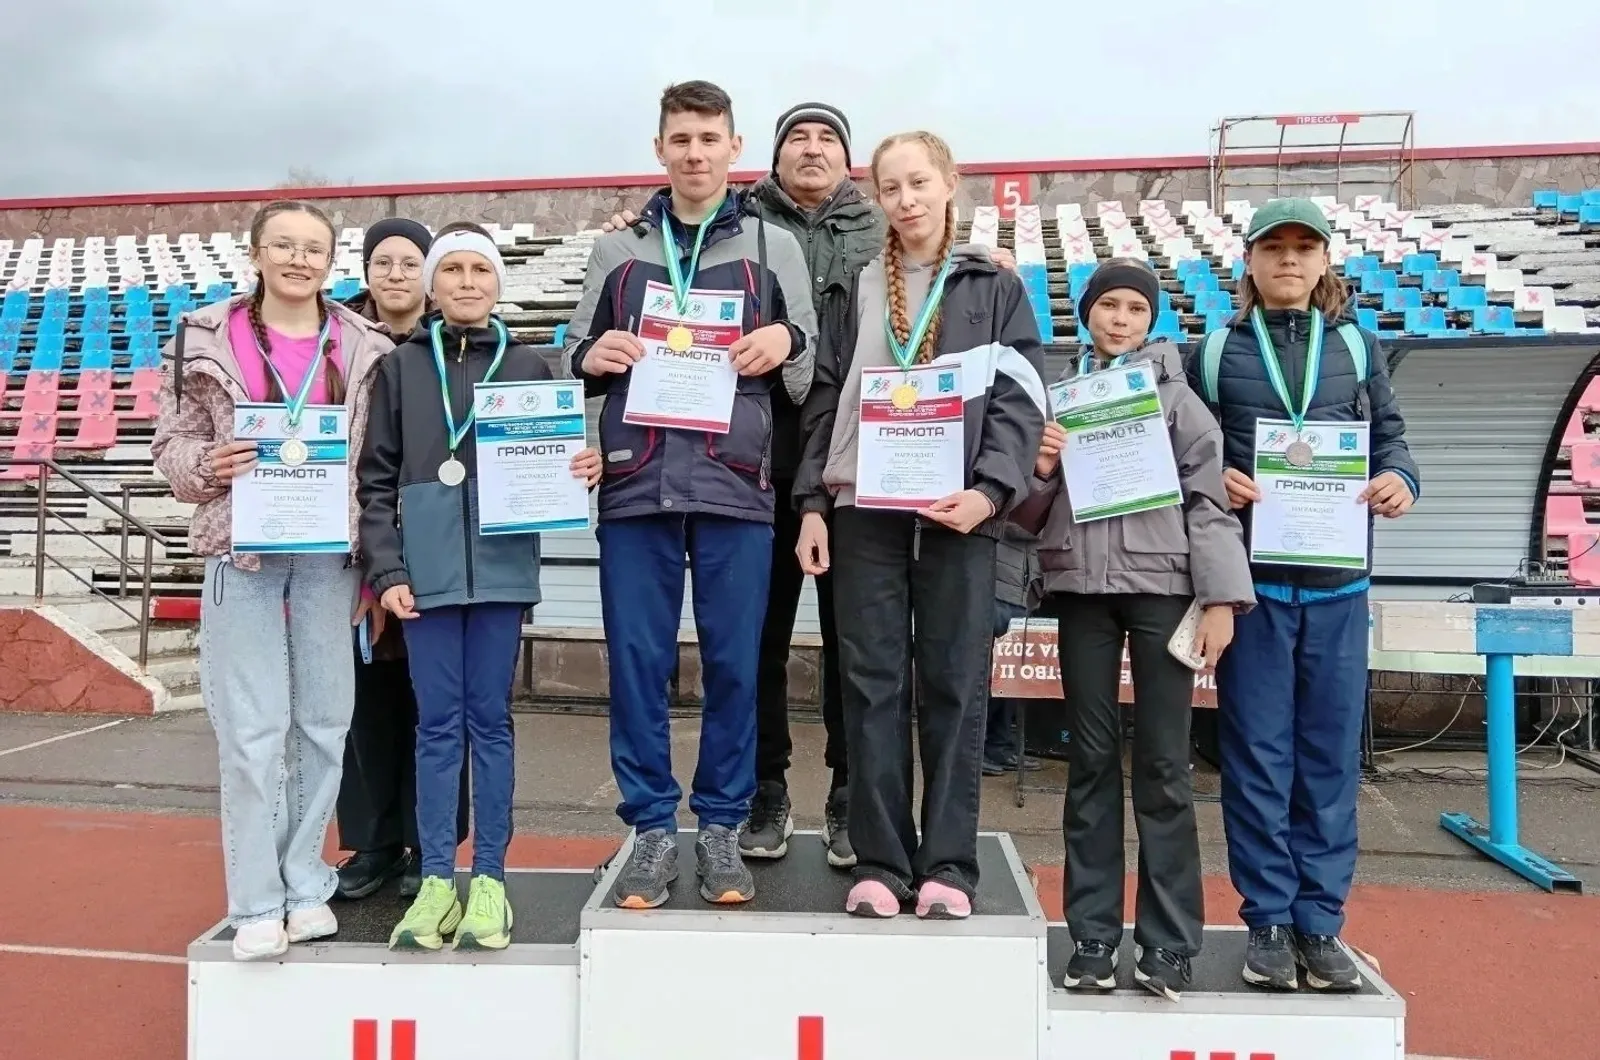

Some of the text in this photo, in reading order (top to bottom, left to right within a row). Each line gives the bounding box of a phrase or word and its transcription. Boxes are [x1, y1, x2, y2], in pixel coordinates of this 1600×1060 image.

[1297, 116, 1339, 124] ПРЕССА
[1003, 181, 1022, 211] 5
[656, 346, 721, 363] ГРАМОТА
[879, 426, 945, 437] ГРАМОТА
[1078, 423, 1145, 444] ГРАМОТА
[497, 444, 566, 457] ГРАМОТА
[254, 468, 327, 478] ГРАМОТА
[1275, 480, 1345, 492] ГРАМОТА
[997, 642, 1035, 657] 2021
